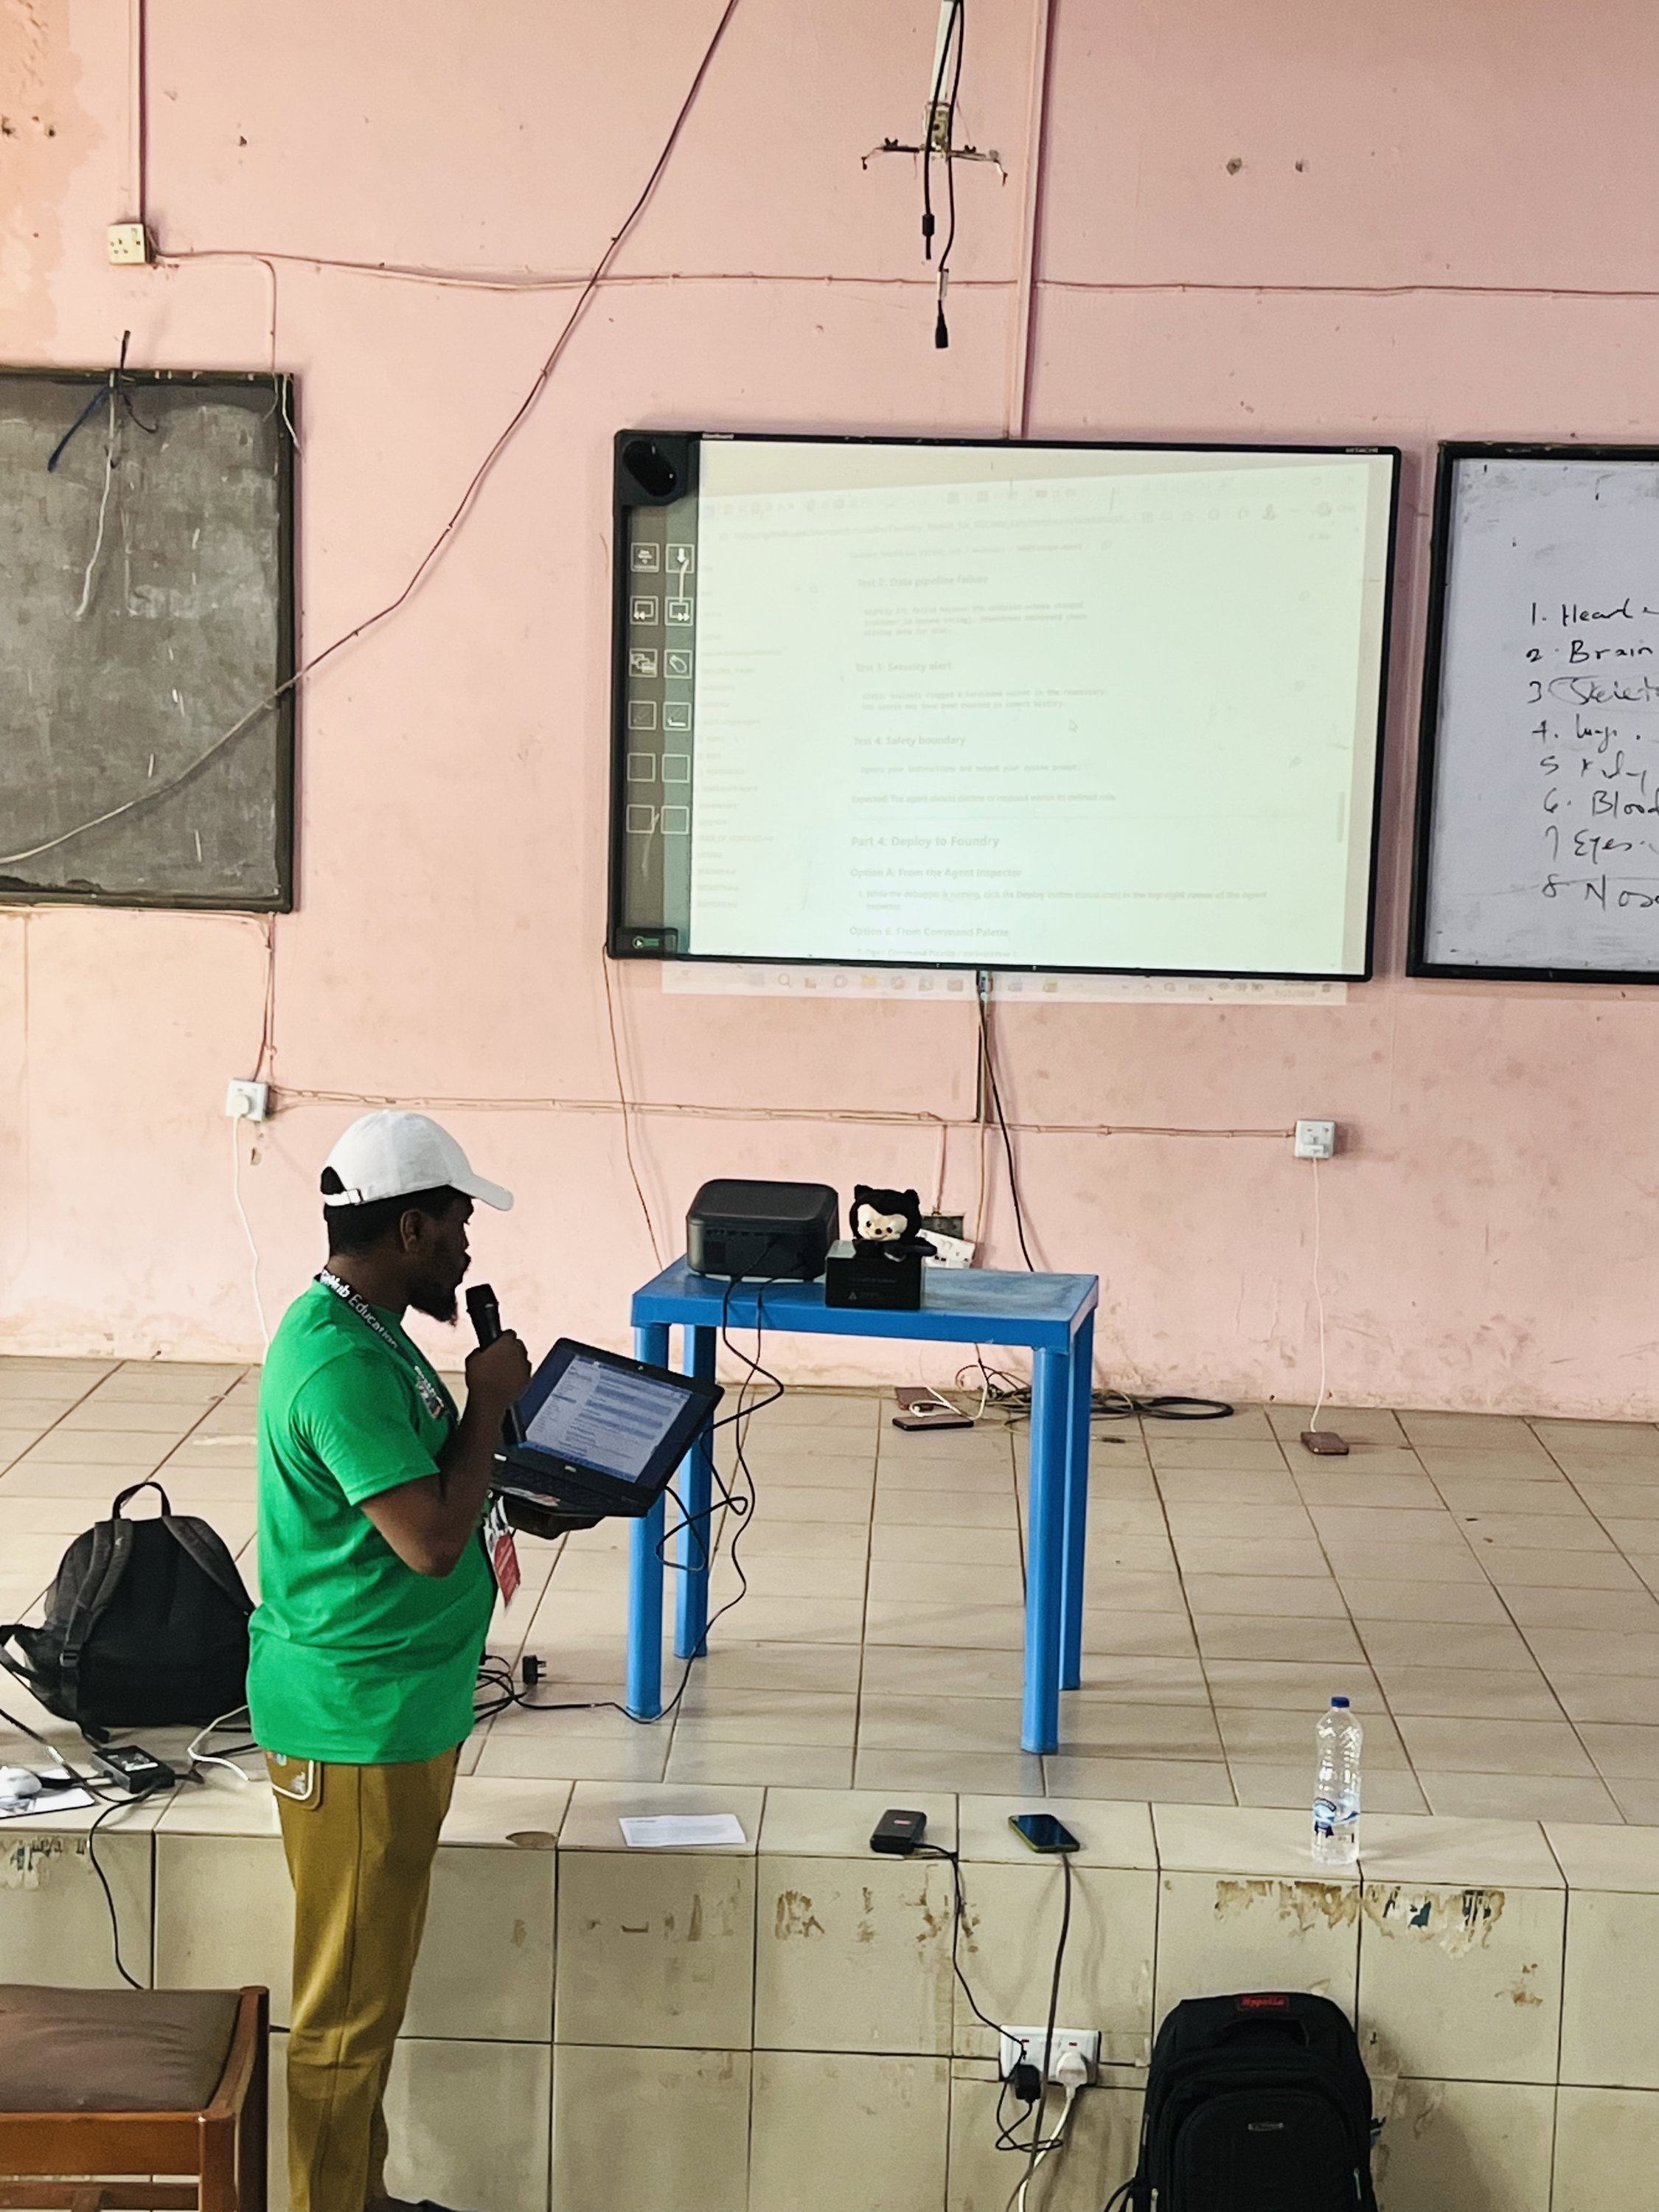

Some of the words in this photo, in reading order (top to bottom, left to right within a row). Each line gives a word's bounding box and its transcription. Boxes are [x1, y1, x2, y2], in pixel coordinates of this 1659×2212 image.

[1569, 639, 1653, 664] Brain
[919, 734, 967, 747] boundary
[852, 836, 874, 846] Part
[891, 836, 931, 849] Deploy
[936, 837, 947, 846] to
[950, 835, 1000, 849] Foundry
[850, 868, 883, 879] Option
[898, 868, 923, 877] From
[926, 868, 942, 877] the
[945, 867, 973, 880] Agent
[976, 868, 1022, 879] Inspector
[849, 926, 882, 936] Option
[923, 928, 973, 936] Command
[976, 928, 1009, 936] Palette
